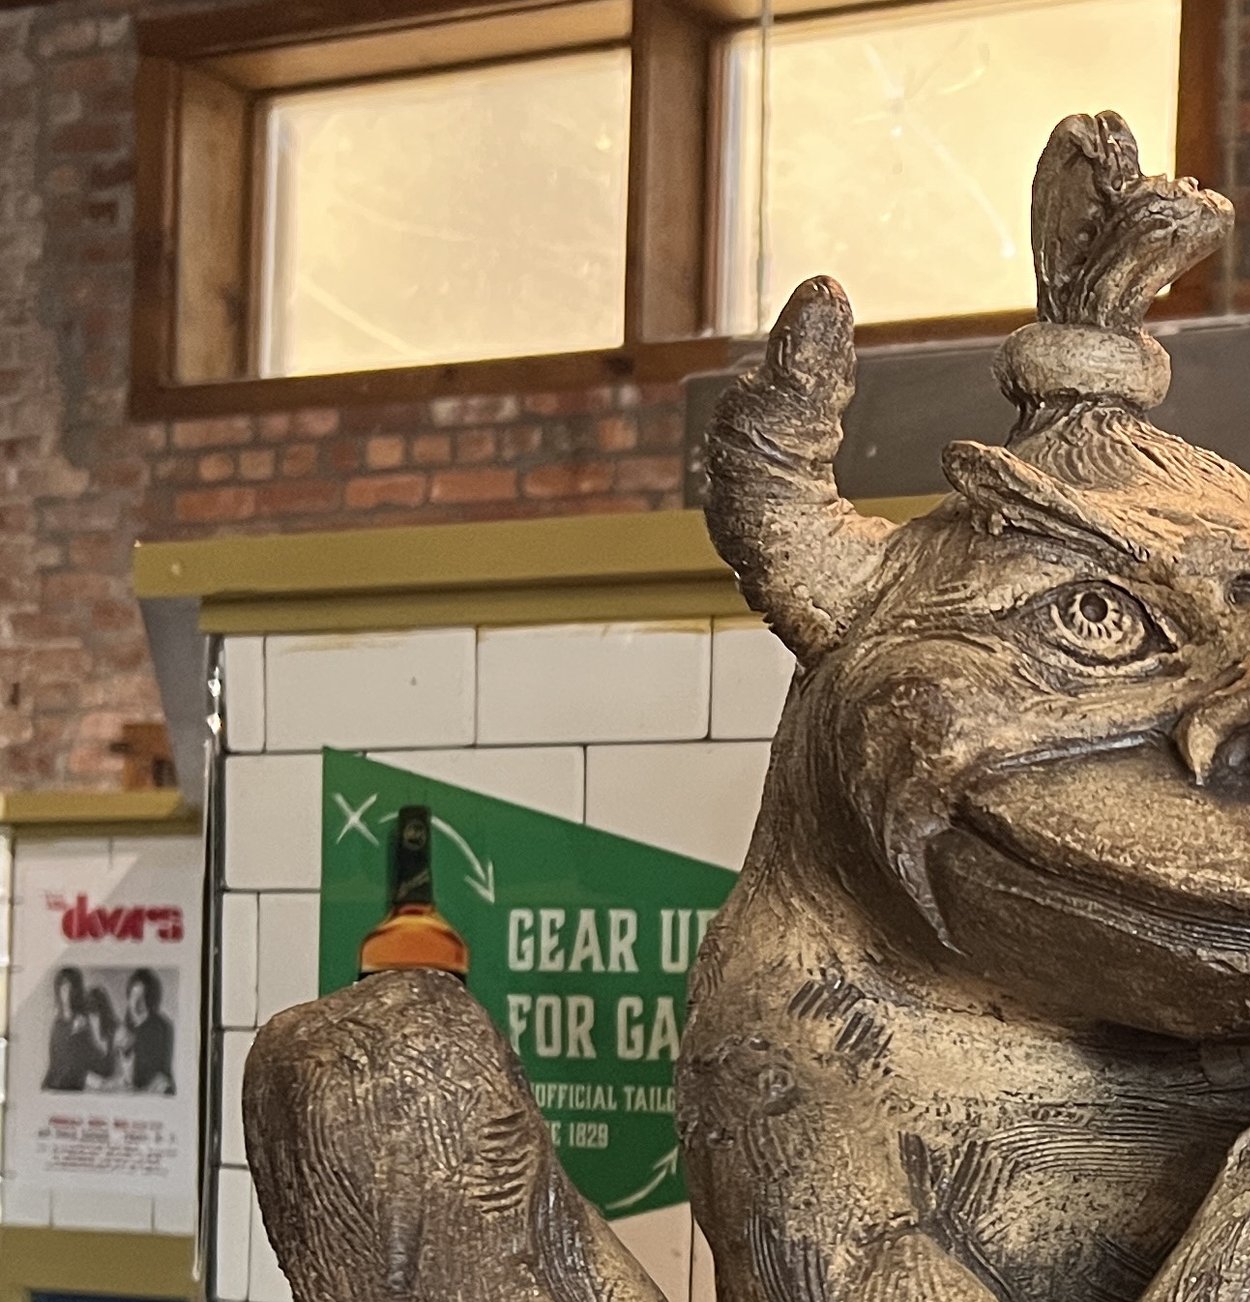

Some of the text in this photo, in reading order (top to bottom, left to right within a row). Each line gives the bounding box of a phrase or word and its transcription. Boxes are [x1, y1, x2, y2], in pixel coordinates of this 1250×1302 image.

[508, 908, 639, 973] GEAR
[507, 994, 597, 1059] FOR
[531, 1083, 617, 1111] OFFICIAL
[570, 1122, 608, 1148] 1829
